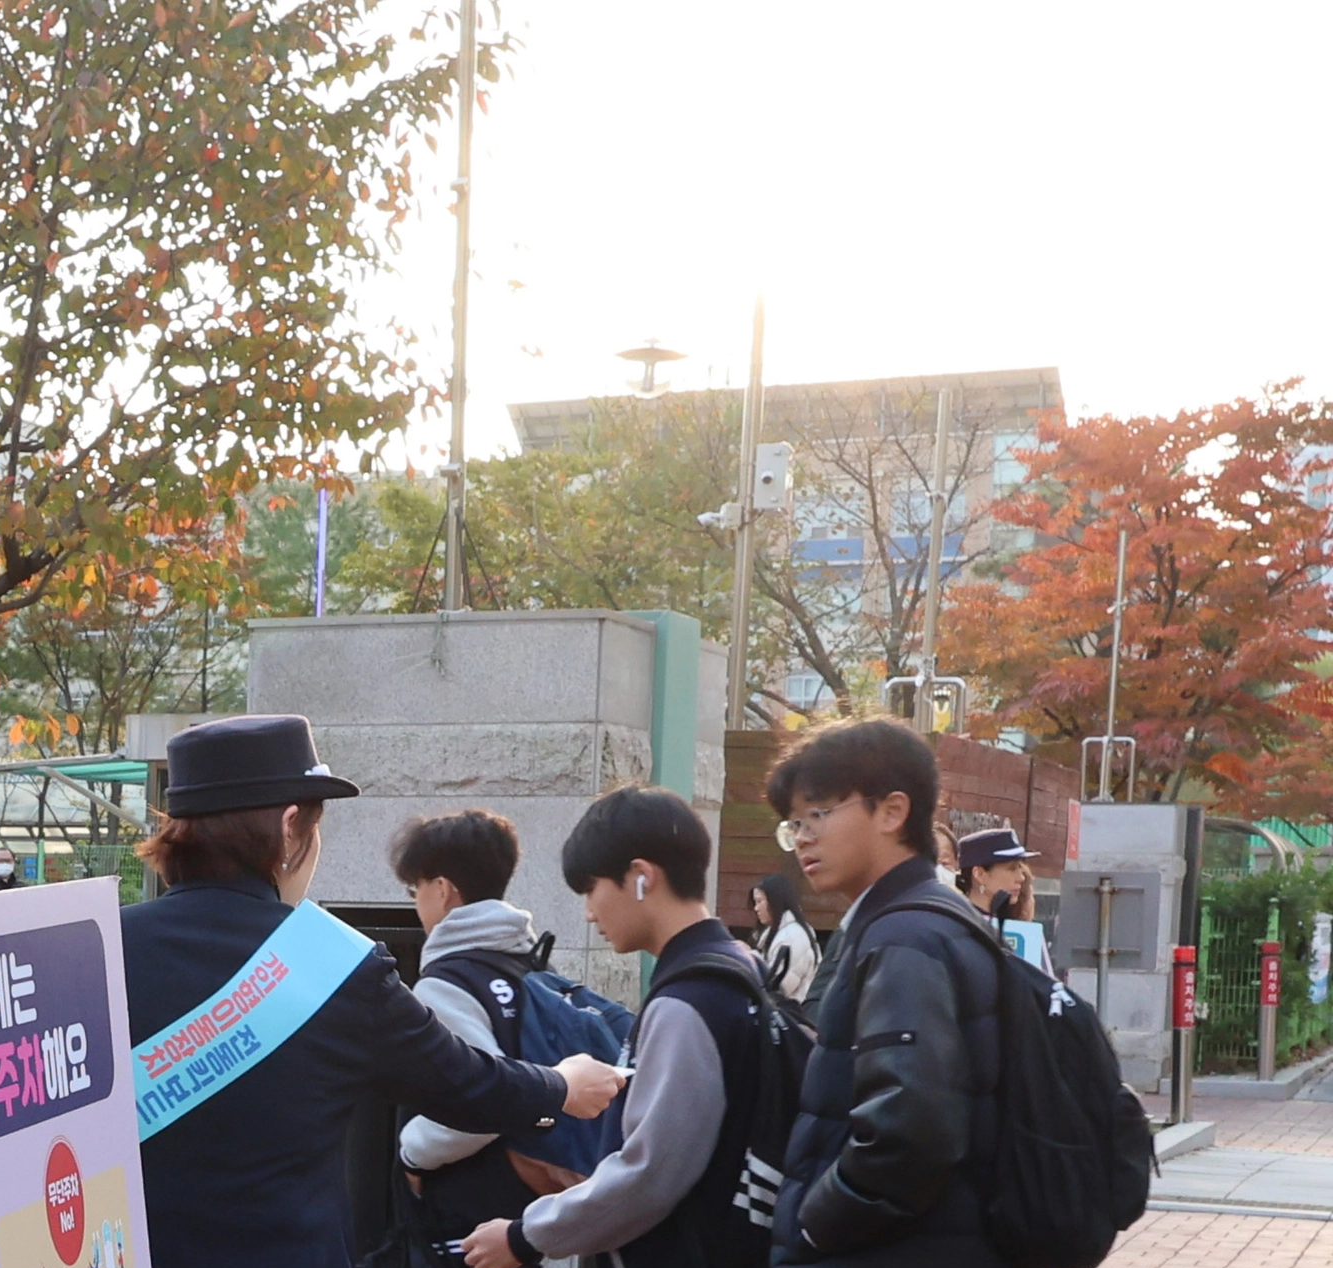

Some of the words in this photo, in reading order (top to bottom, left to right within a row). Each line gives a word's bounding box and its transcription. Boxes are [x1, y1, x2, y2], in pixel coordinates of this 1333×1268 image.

[138, 951, 290, 1080] 개인형이동장치
[135, 1024, 262, 1126] 전동킥보드
[47, 1173, 79, 1208] 무단주차
[60, 1210, 75, 1234] No!
